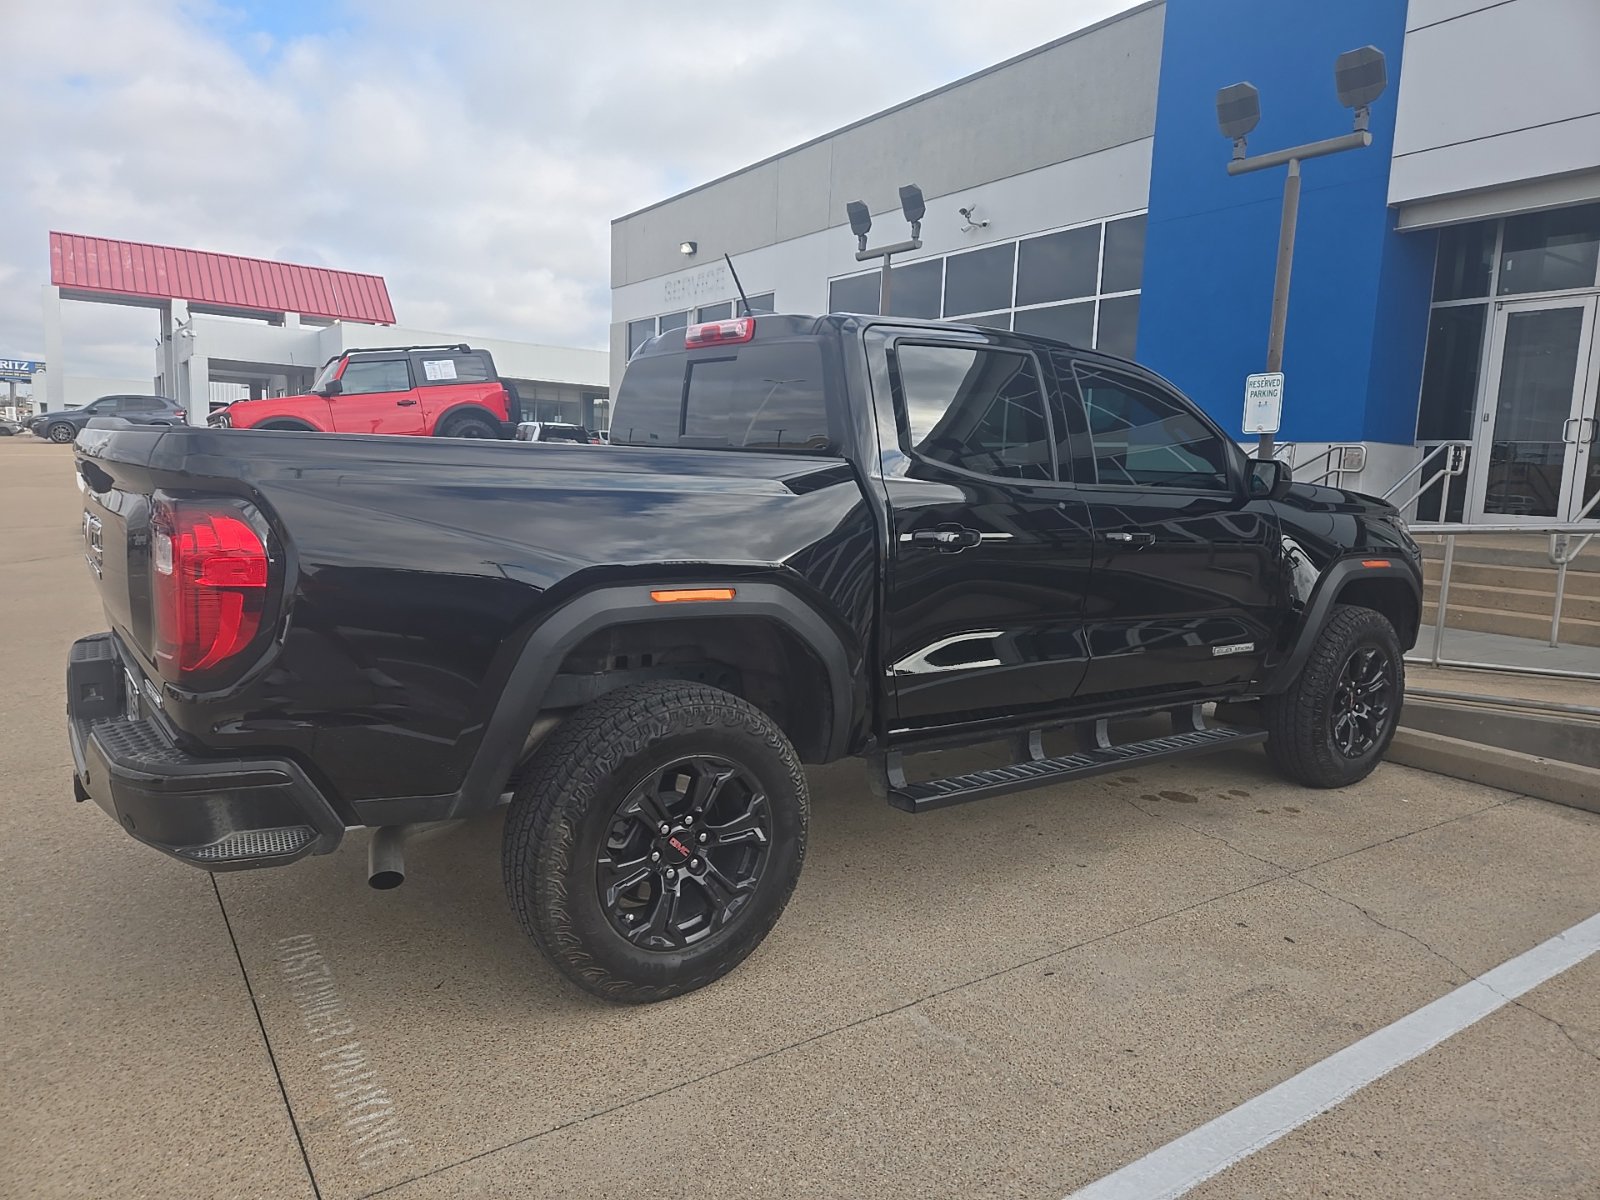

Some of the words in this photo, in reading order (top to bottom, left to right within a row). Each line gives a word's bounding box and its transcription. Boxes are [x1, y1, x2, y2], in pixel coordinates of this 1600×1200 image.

[0, 360, 29, 371] RITZ
[1249, 379, 1280, 388] RESERVED
[1250, 389, 1278, 398] PARKING
[669, 837, 690, 857] GMC
